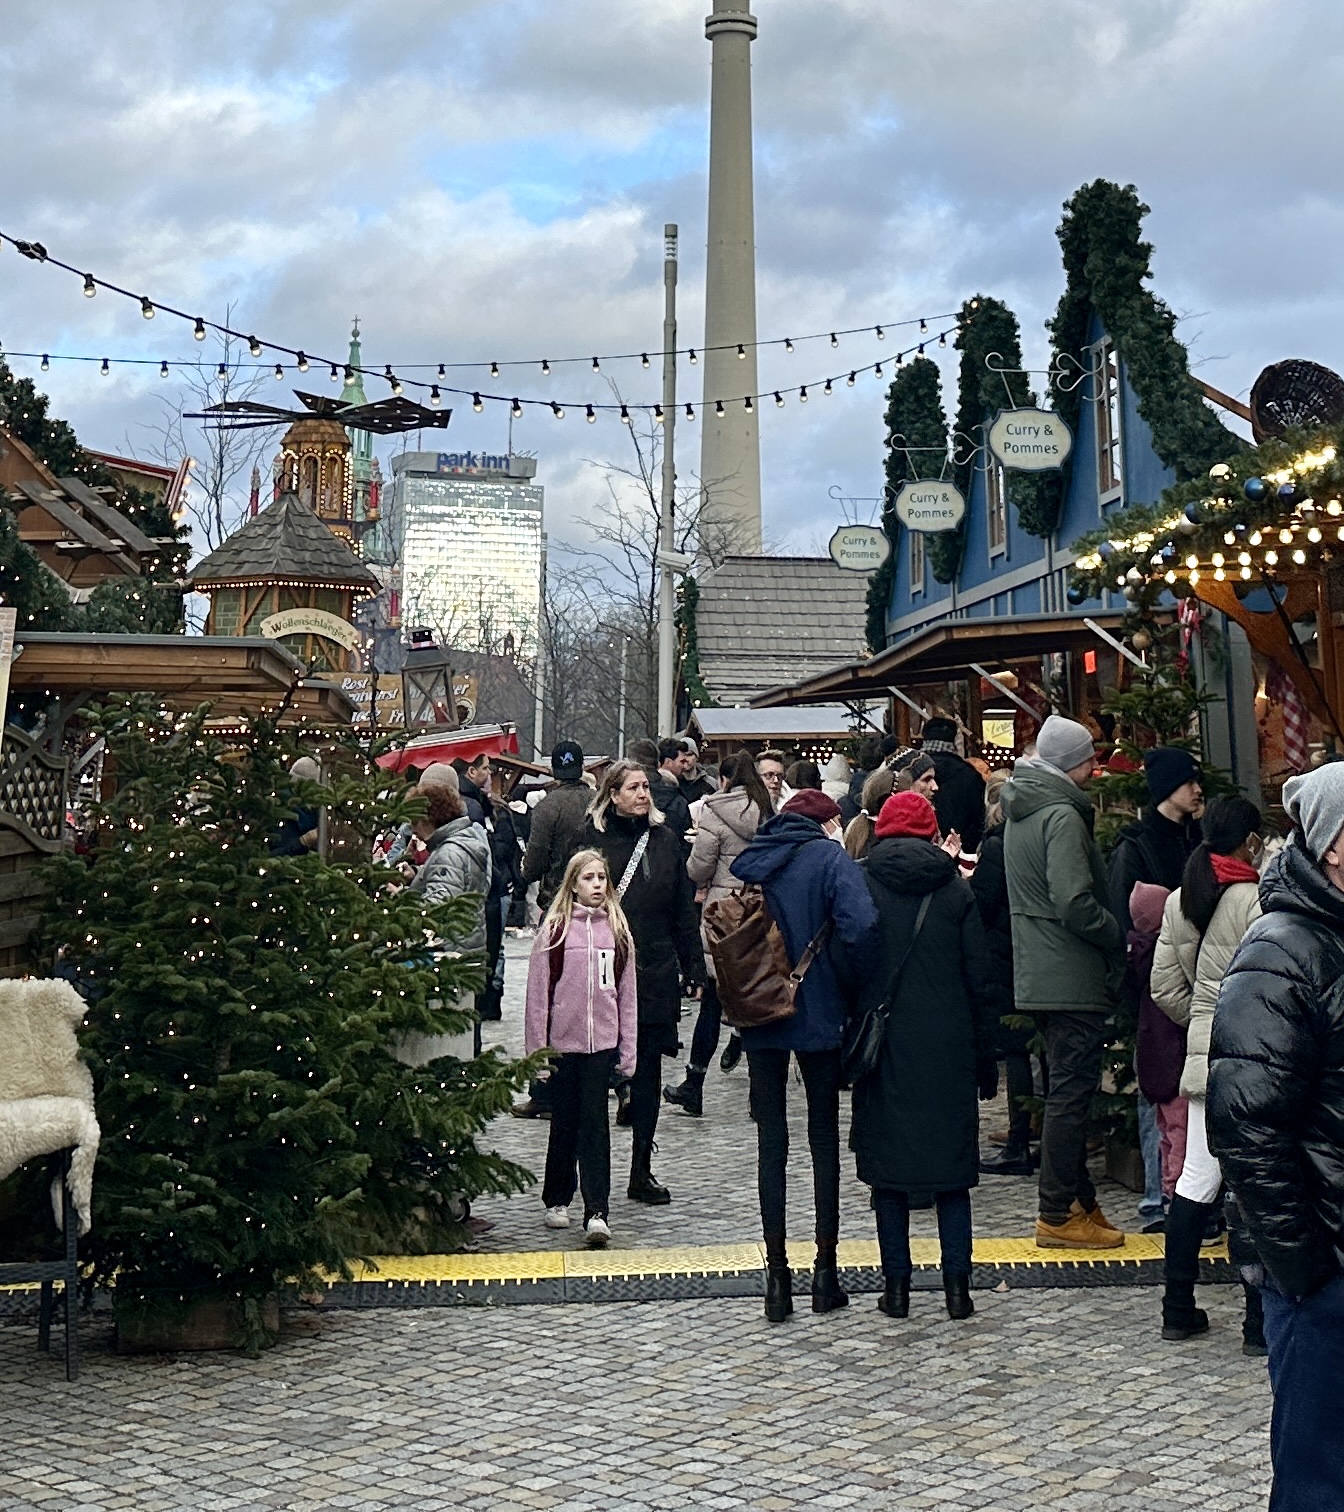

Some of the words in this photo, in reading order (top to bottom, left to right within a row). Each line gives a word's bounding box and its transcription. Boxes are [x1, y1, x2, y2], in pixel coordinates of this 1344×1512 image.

[1006, 424, 1041, 438] Curry
[1043, 425, 1054, 436] &
[1003, 442, 1059, 455] Pommes
[437, 451, 478, 472] park
[482, 452, 510, 470] inn
[909, 492, 939, 505] Curry
[941, 493, 950, 503] &
[907, 508, 955, 519] Pommes
[842, 535, 868, 547] Curry
[869, 536, 877, 546] &
[840, 549, 881, 559] Pommes
